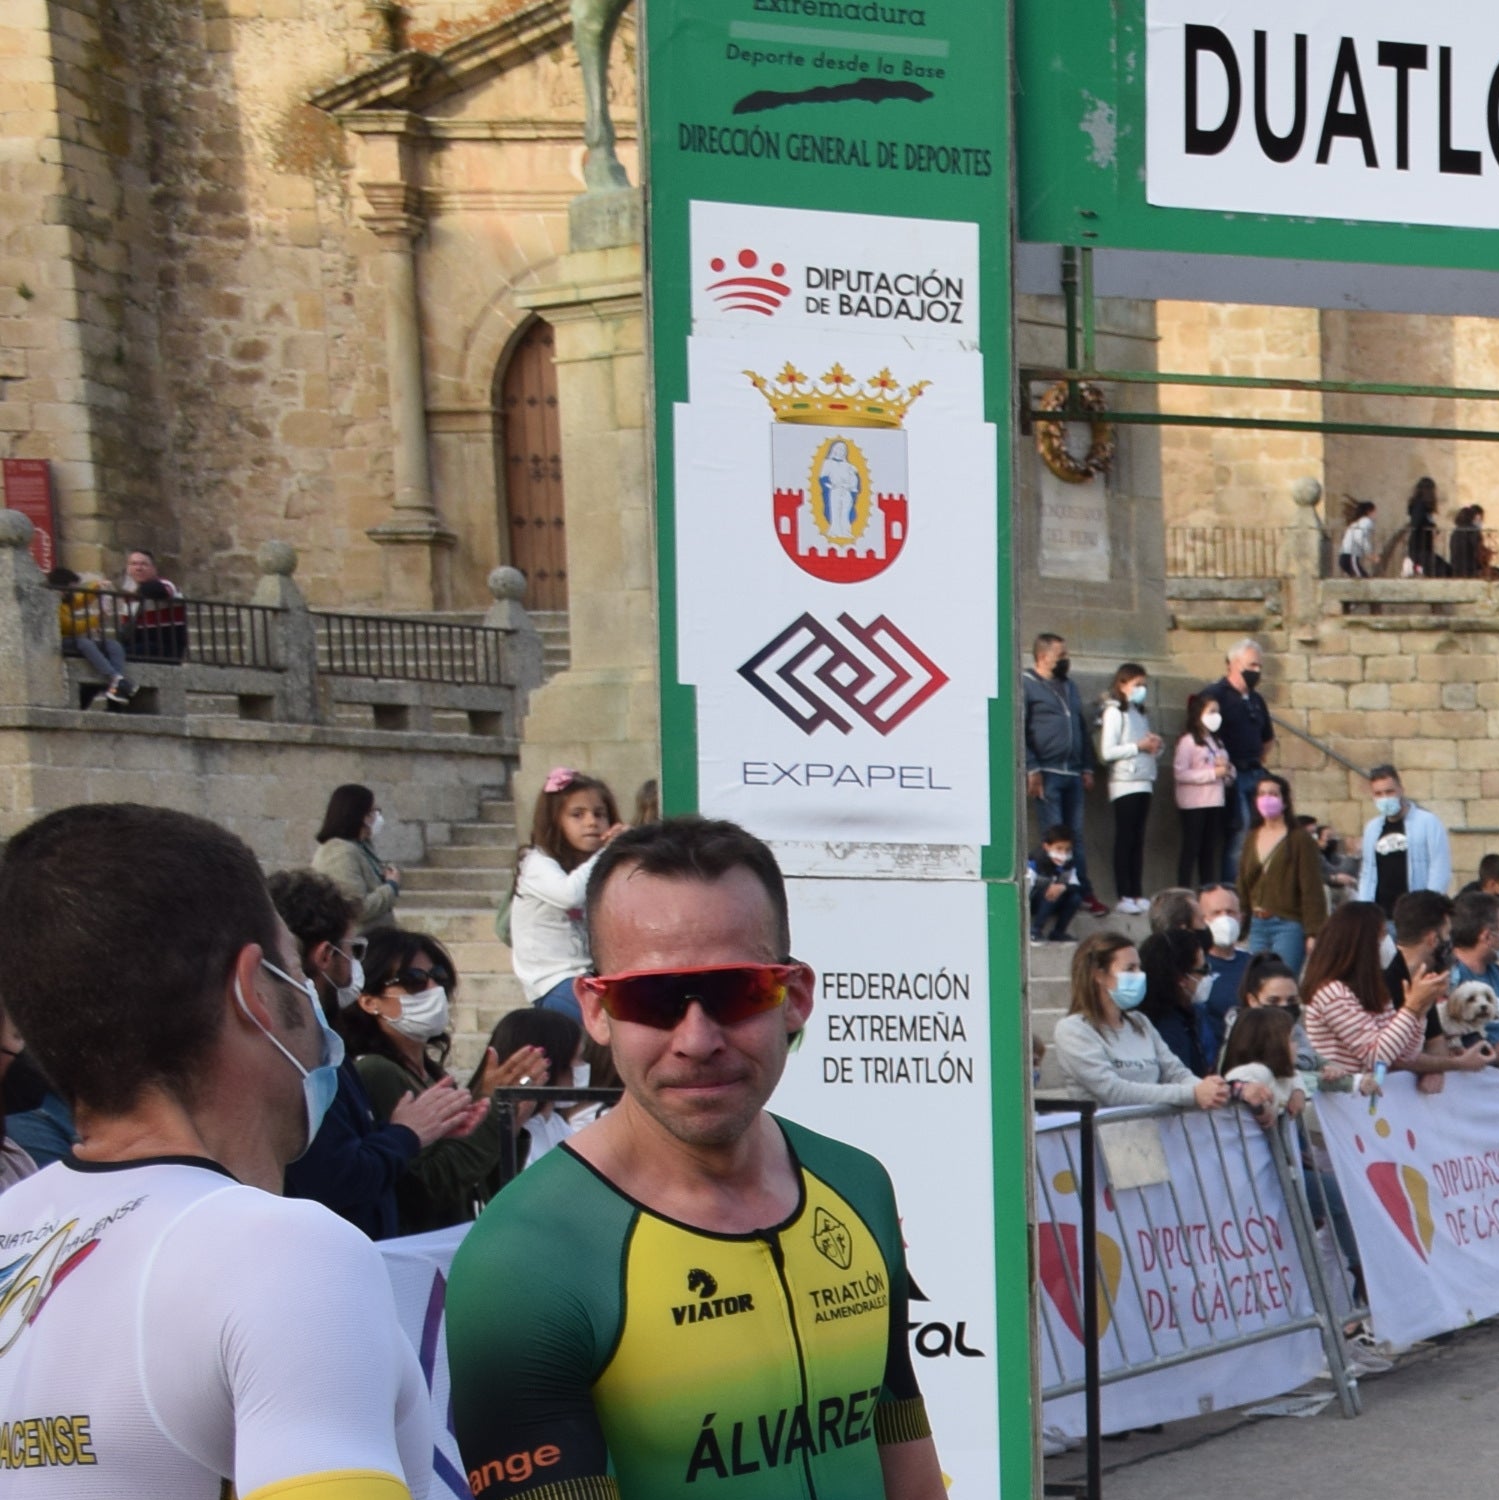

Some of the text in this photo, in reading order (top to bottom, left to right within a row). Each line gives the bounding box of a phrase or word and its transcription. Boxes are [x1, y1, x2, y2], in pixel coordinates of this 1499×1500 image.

[727, 43, 946, 80] Deporte desde la Base
[679, 123, 992, 178] DIRECCIÓN GENERAL DE DEPORTES
[806, 266, 964, 300] DIPUTACIÓN
[806, 295, 964, 324] DE BADAJOZ
[743, 761, 952, 790] EXPAPEL
[822, 966, 970, 1001] FEDERACIÓN
[829, 1010, 967, 1042] EXTREMEÑA
[822, 1050, 973, 1084] DE TRIATLÓN
[1445, 1210, 1468, 1246] DE
[809, 1270, 885, 1309] TRIATLÓN
[671, 1293, 755, 1326] VIATOR
[685, 1386, 881, 1483] ÁLVAREZ
